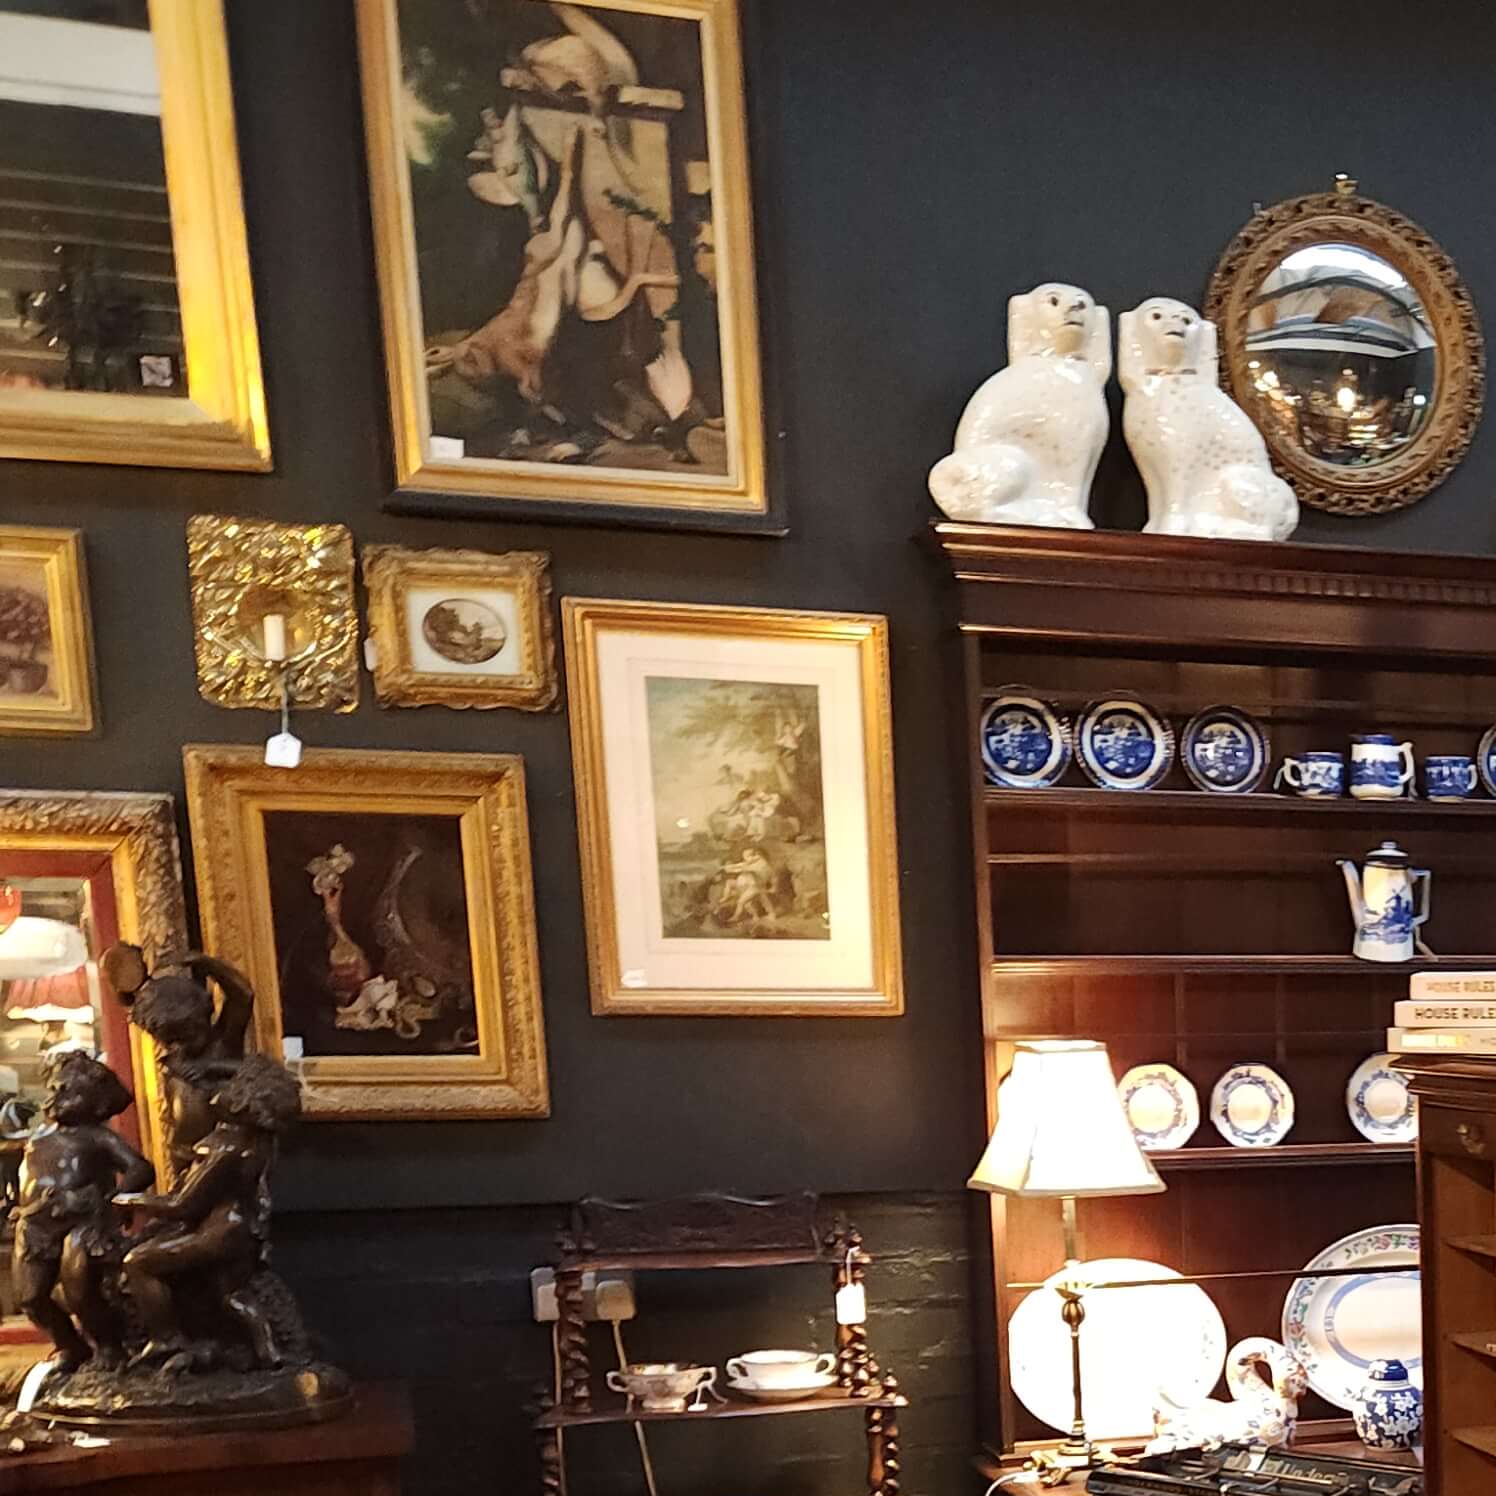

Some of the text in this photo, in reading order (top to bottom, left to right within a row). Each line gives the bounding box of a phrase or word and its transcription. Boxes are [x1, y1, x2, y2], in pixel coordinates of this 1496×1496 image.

[1426, 981, 1460, 994] HOUSE
[1463, 980, 1495, 993] RULES
[1415, 1007, 1458, 1020] HOUSE
